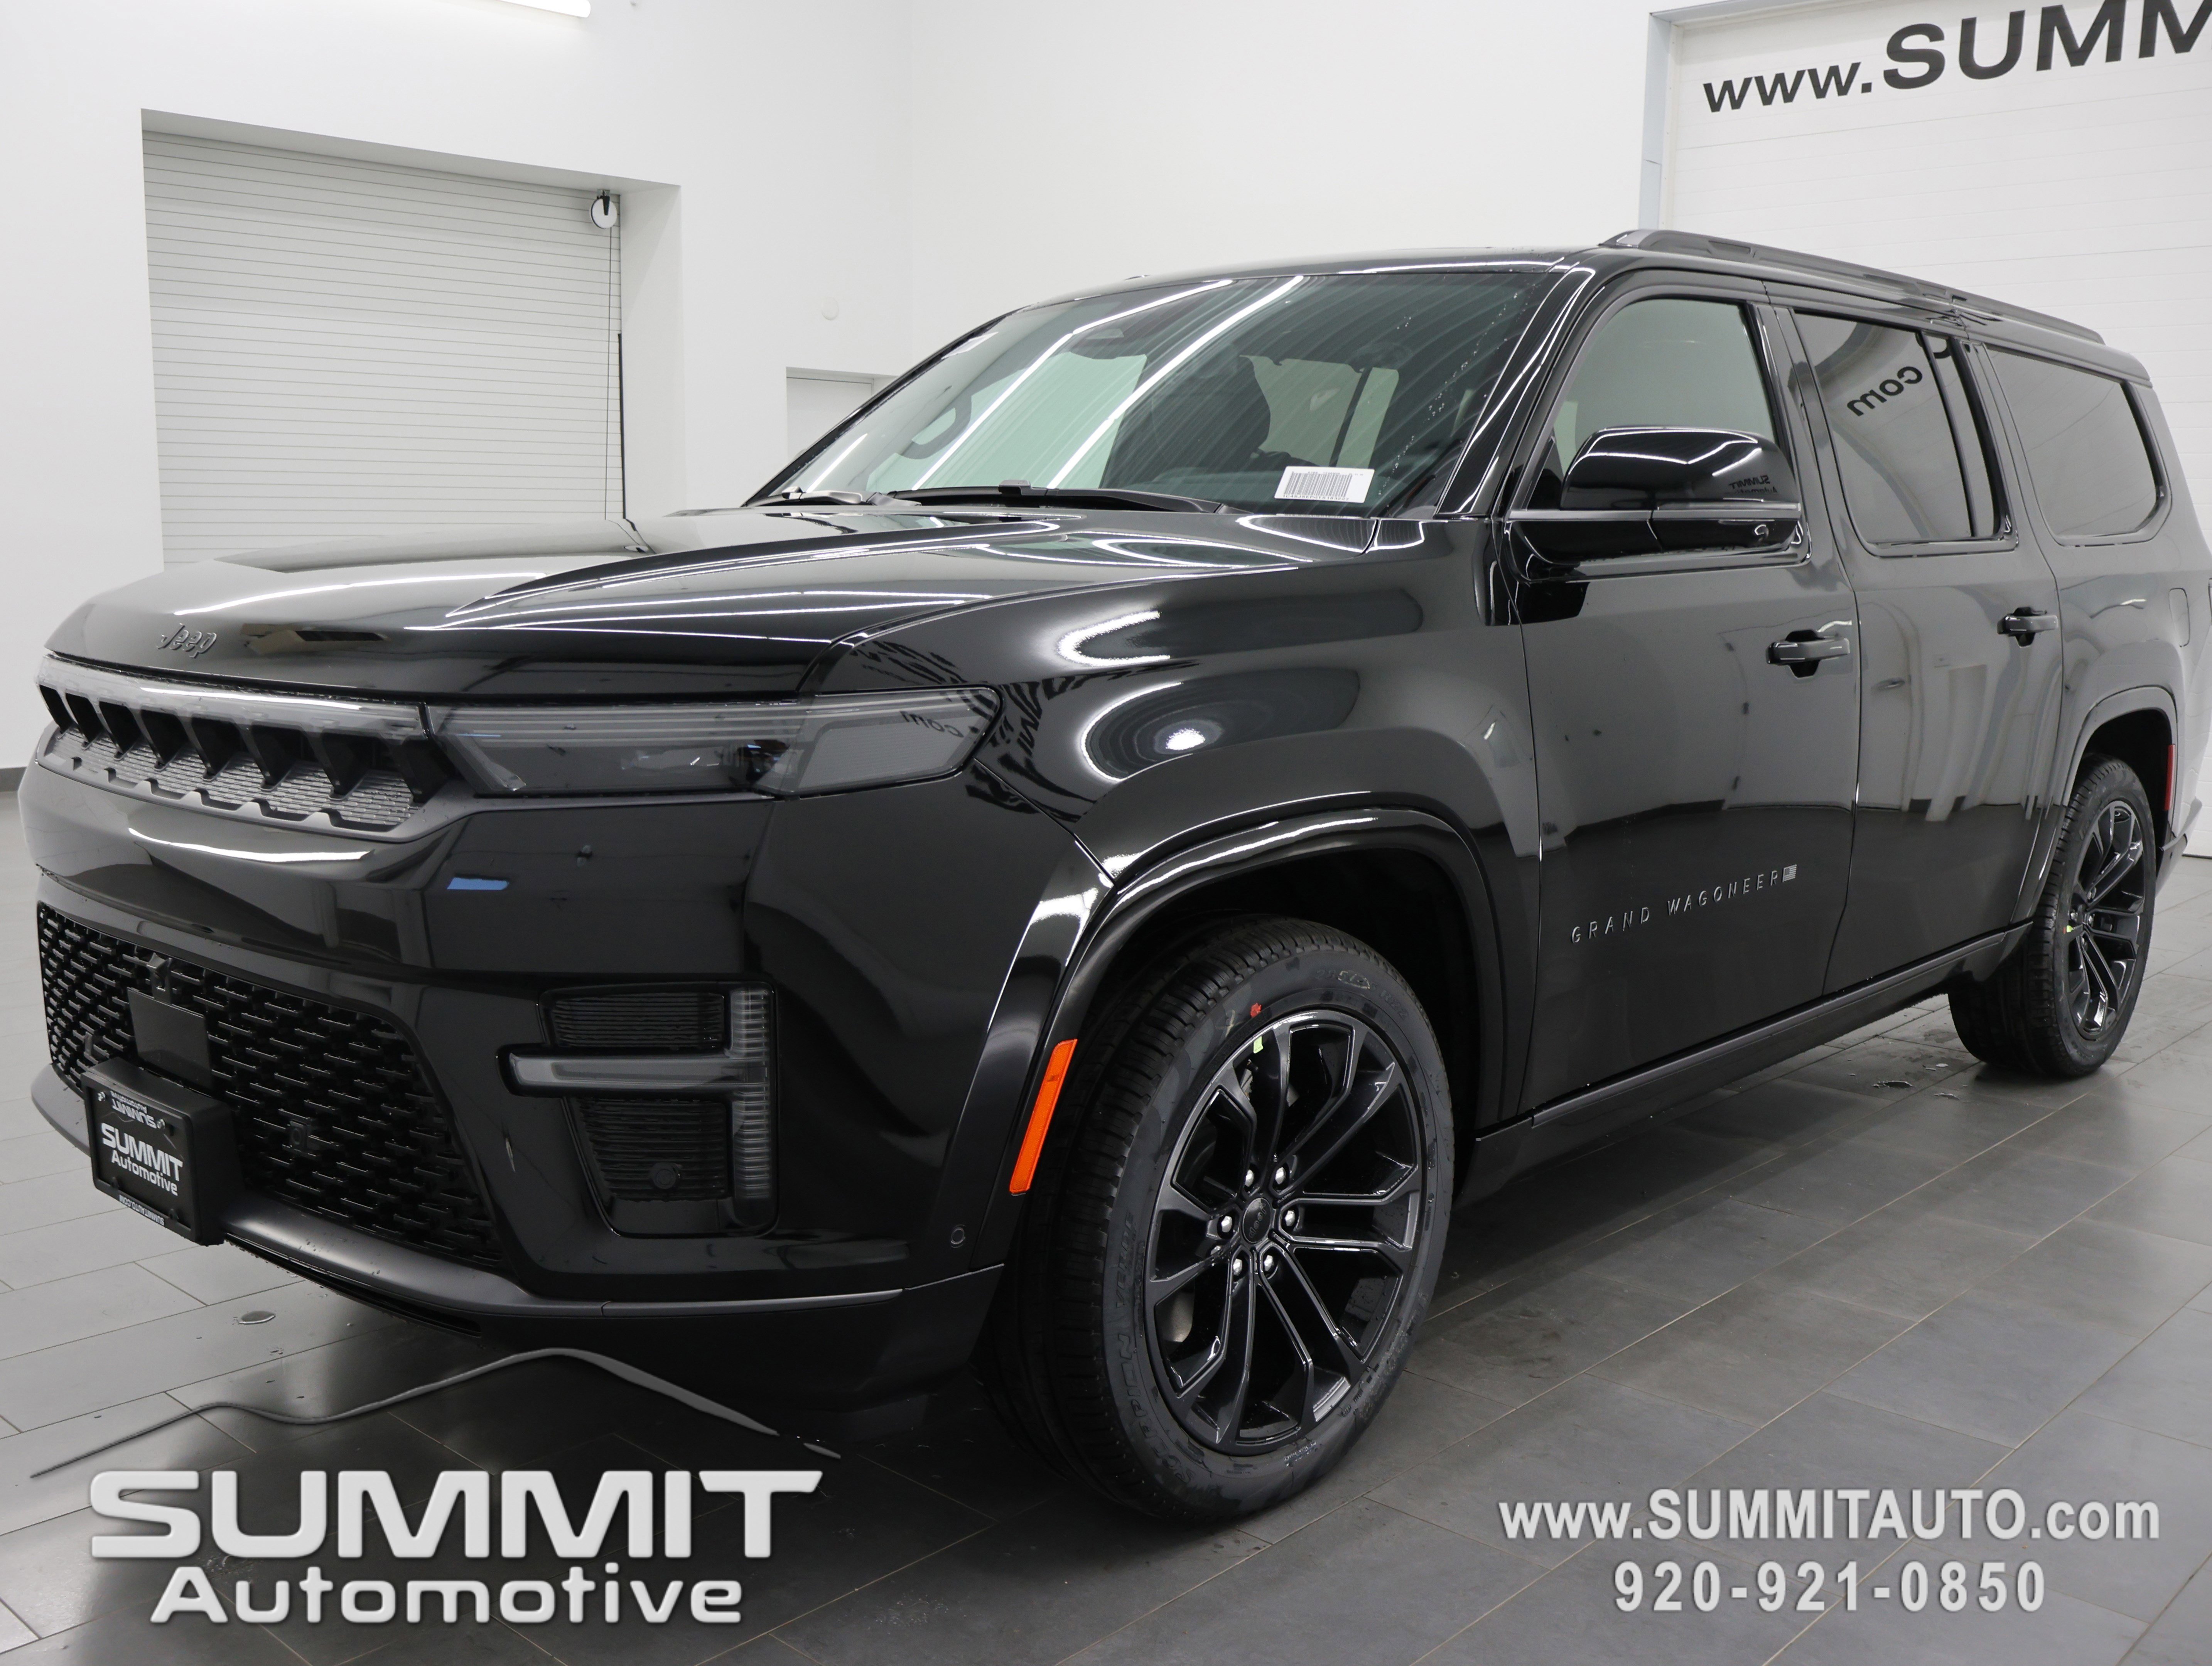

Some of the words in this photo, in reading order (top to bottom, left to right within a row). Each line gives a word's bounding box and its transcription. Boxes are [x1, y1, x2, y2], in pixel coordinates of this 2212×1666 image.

[156, 623, 217, 659] Jeep
[1571, 906, 1650, 944] GRAND
[1667, 870, 1778, 916] WAGONEER
[111, 1098, 157, 1129] SUMMIT
[100, 1122, 183, 1182] SUMMIT
[111, 1150, 178, 1197] Automotive
[1249, 1201, 1267, 1238] Jeep
[1118, 1333, 1196, 1484] SCORPION
